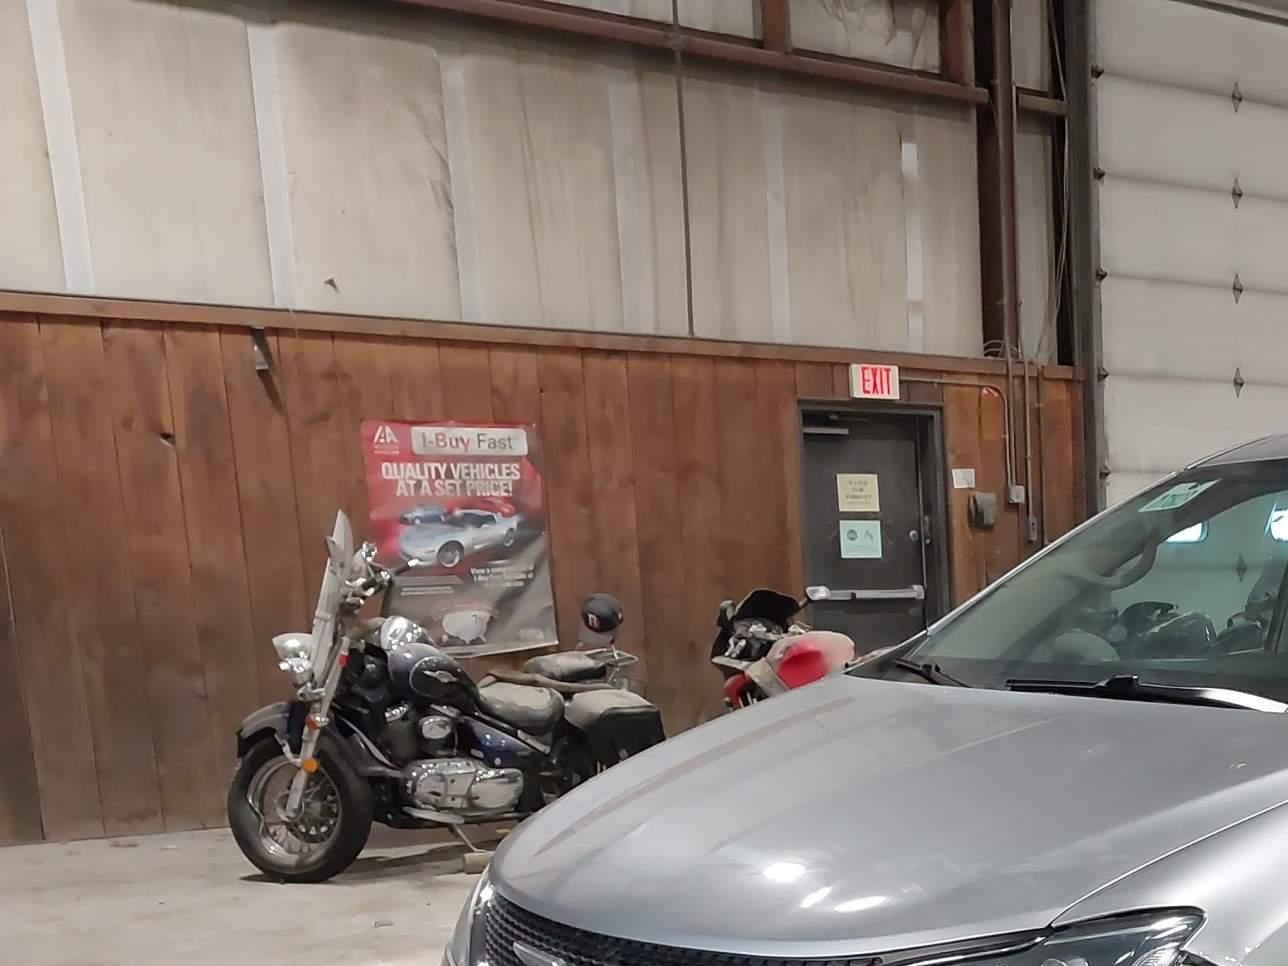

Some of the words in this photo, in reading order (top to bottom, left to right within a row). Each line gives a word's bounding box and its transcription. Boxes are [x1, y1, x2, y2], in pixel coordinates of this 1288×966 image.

[861, 367, 891, 395] EXIT
[422, 432, 471, 452] I-Buy
[477, 432, 514, 450] Fast
[381, 462, 447, 480] QUALITY
[449, 462, 521, 481] VEHICLES
[396, 480, 417, 497] AT
[419, 480, 433, 497] A
[434, 480, 462, 497] SET
[465, 480, 513, 497] PRICE!
